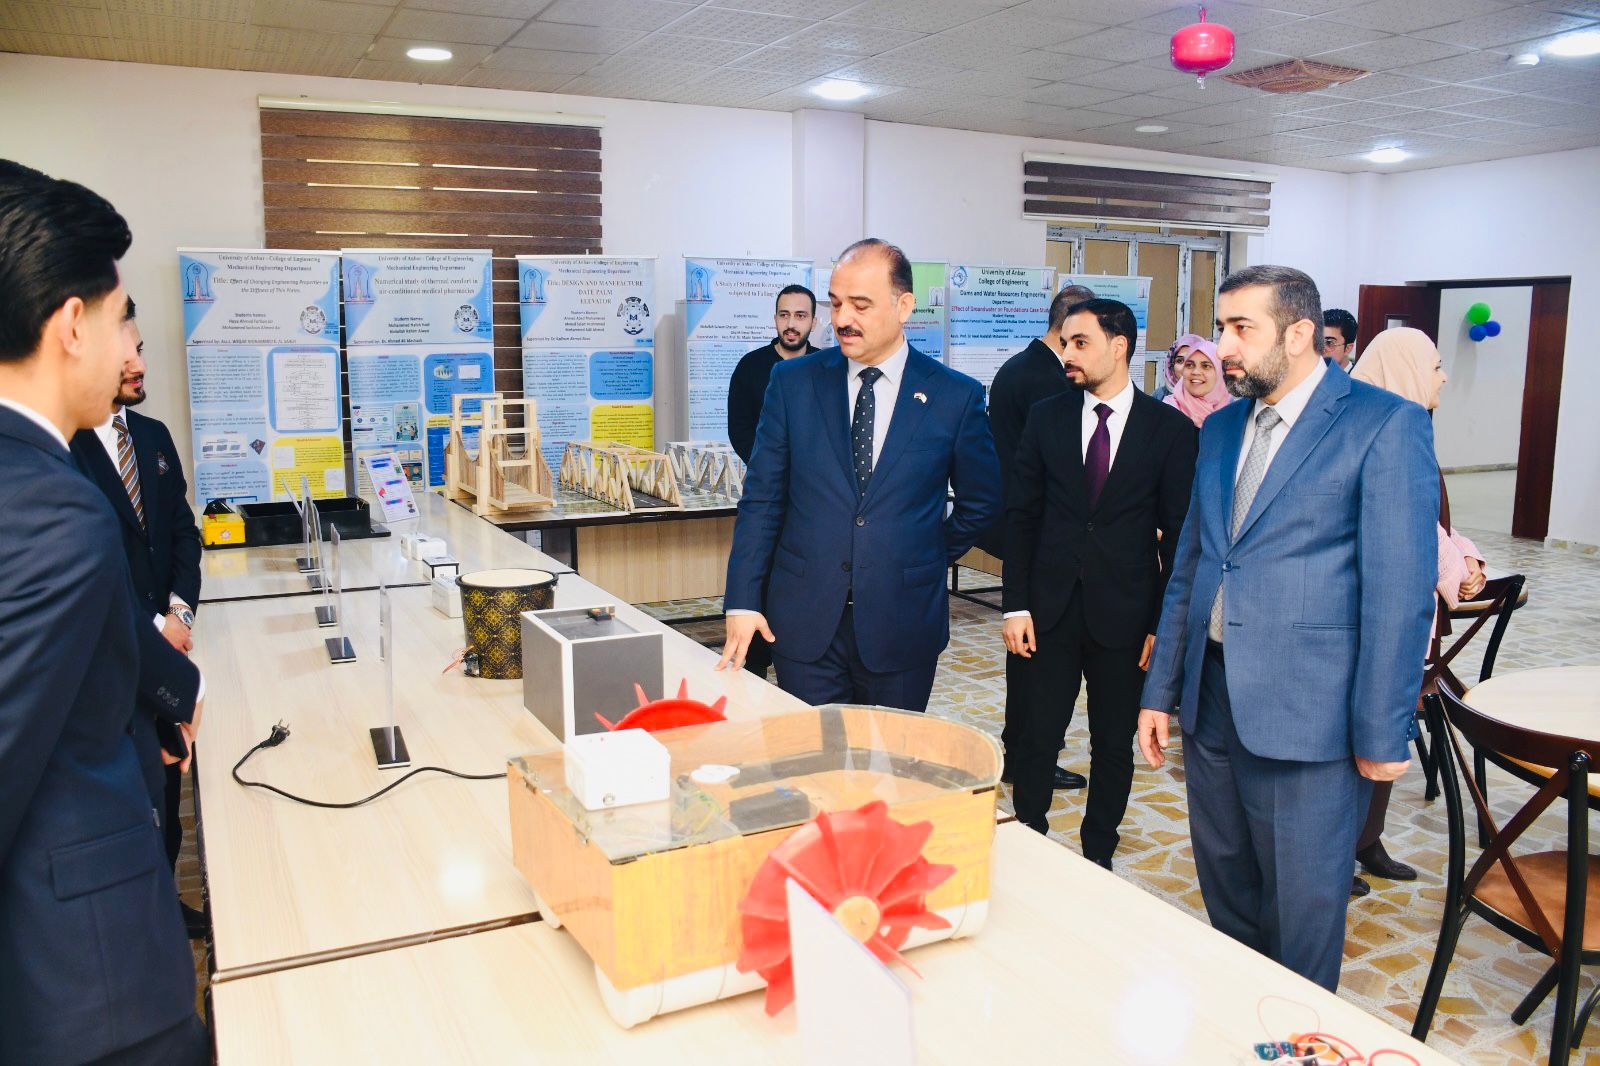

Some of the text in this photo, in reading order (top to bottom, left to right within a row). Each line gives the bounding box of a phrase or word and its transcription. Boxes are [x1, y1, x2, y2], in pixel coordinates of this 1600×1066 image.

[405, 278, 419, 286] study
[1001, 278, 1029, 287] Engineering
[1020, 291, 1046, 299] Engineering
